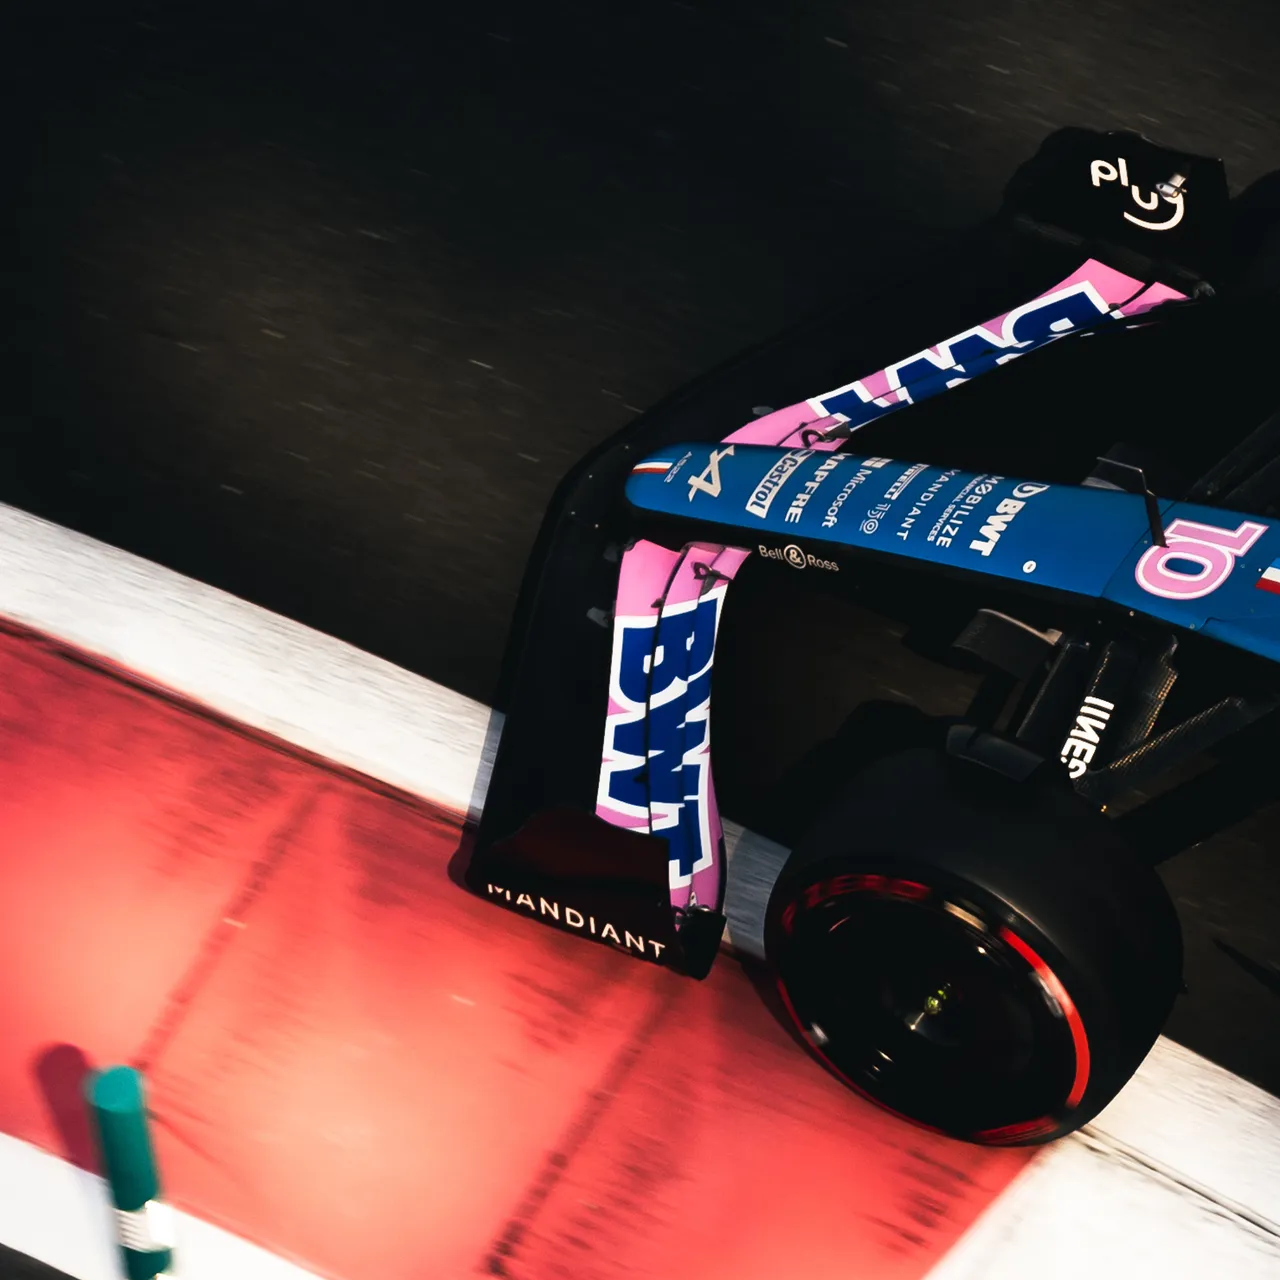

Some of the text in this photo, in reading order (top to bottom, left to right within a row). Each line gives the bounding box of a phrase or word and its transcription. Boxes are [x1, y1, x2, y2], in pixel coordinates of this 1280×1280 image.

[750, 457, 797, 509] Castrol
[785, 453, 853, 523] MAPFRE
[821, 468, 872, 528] Microsoft
[896, 469, 961, 541] MANDIANT
[758, 545, 784, 561] Bell
[807, 554, 840, 572] Ross
[969, 498, 1027, 557] BWT
[1135, 518, 1269, 600] 10
[597, 582, 728, 888] BWT
[487, 884, 666, 959] MANDIANT
